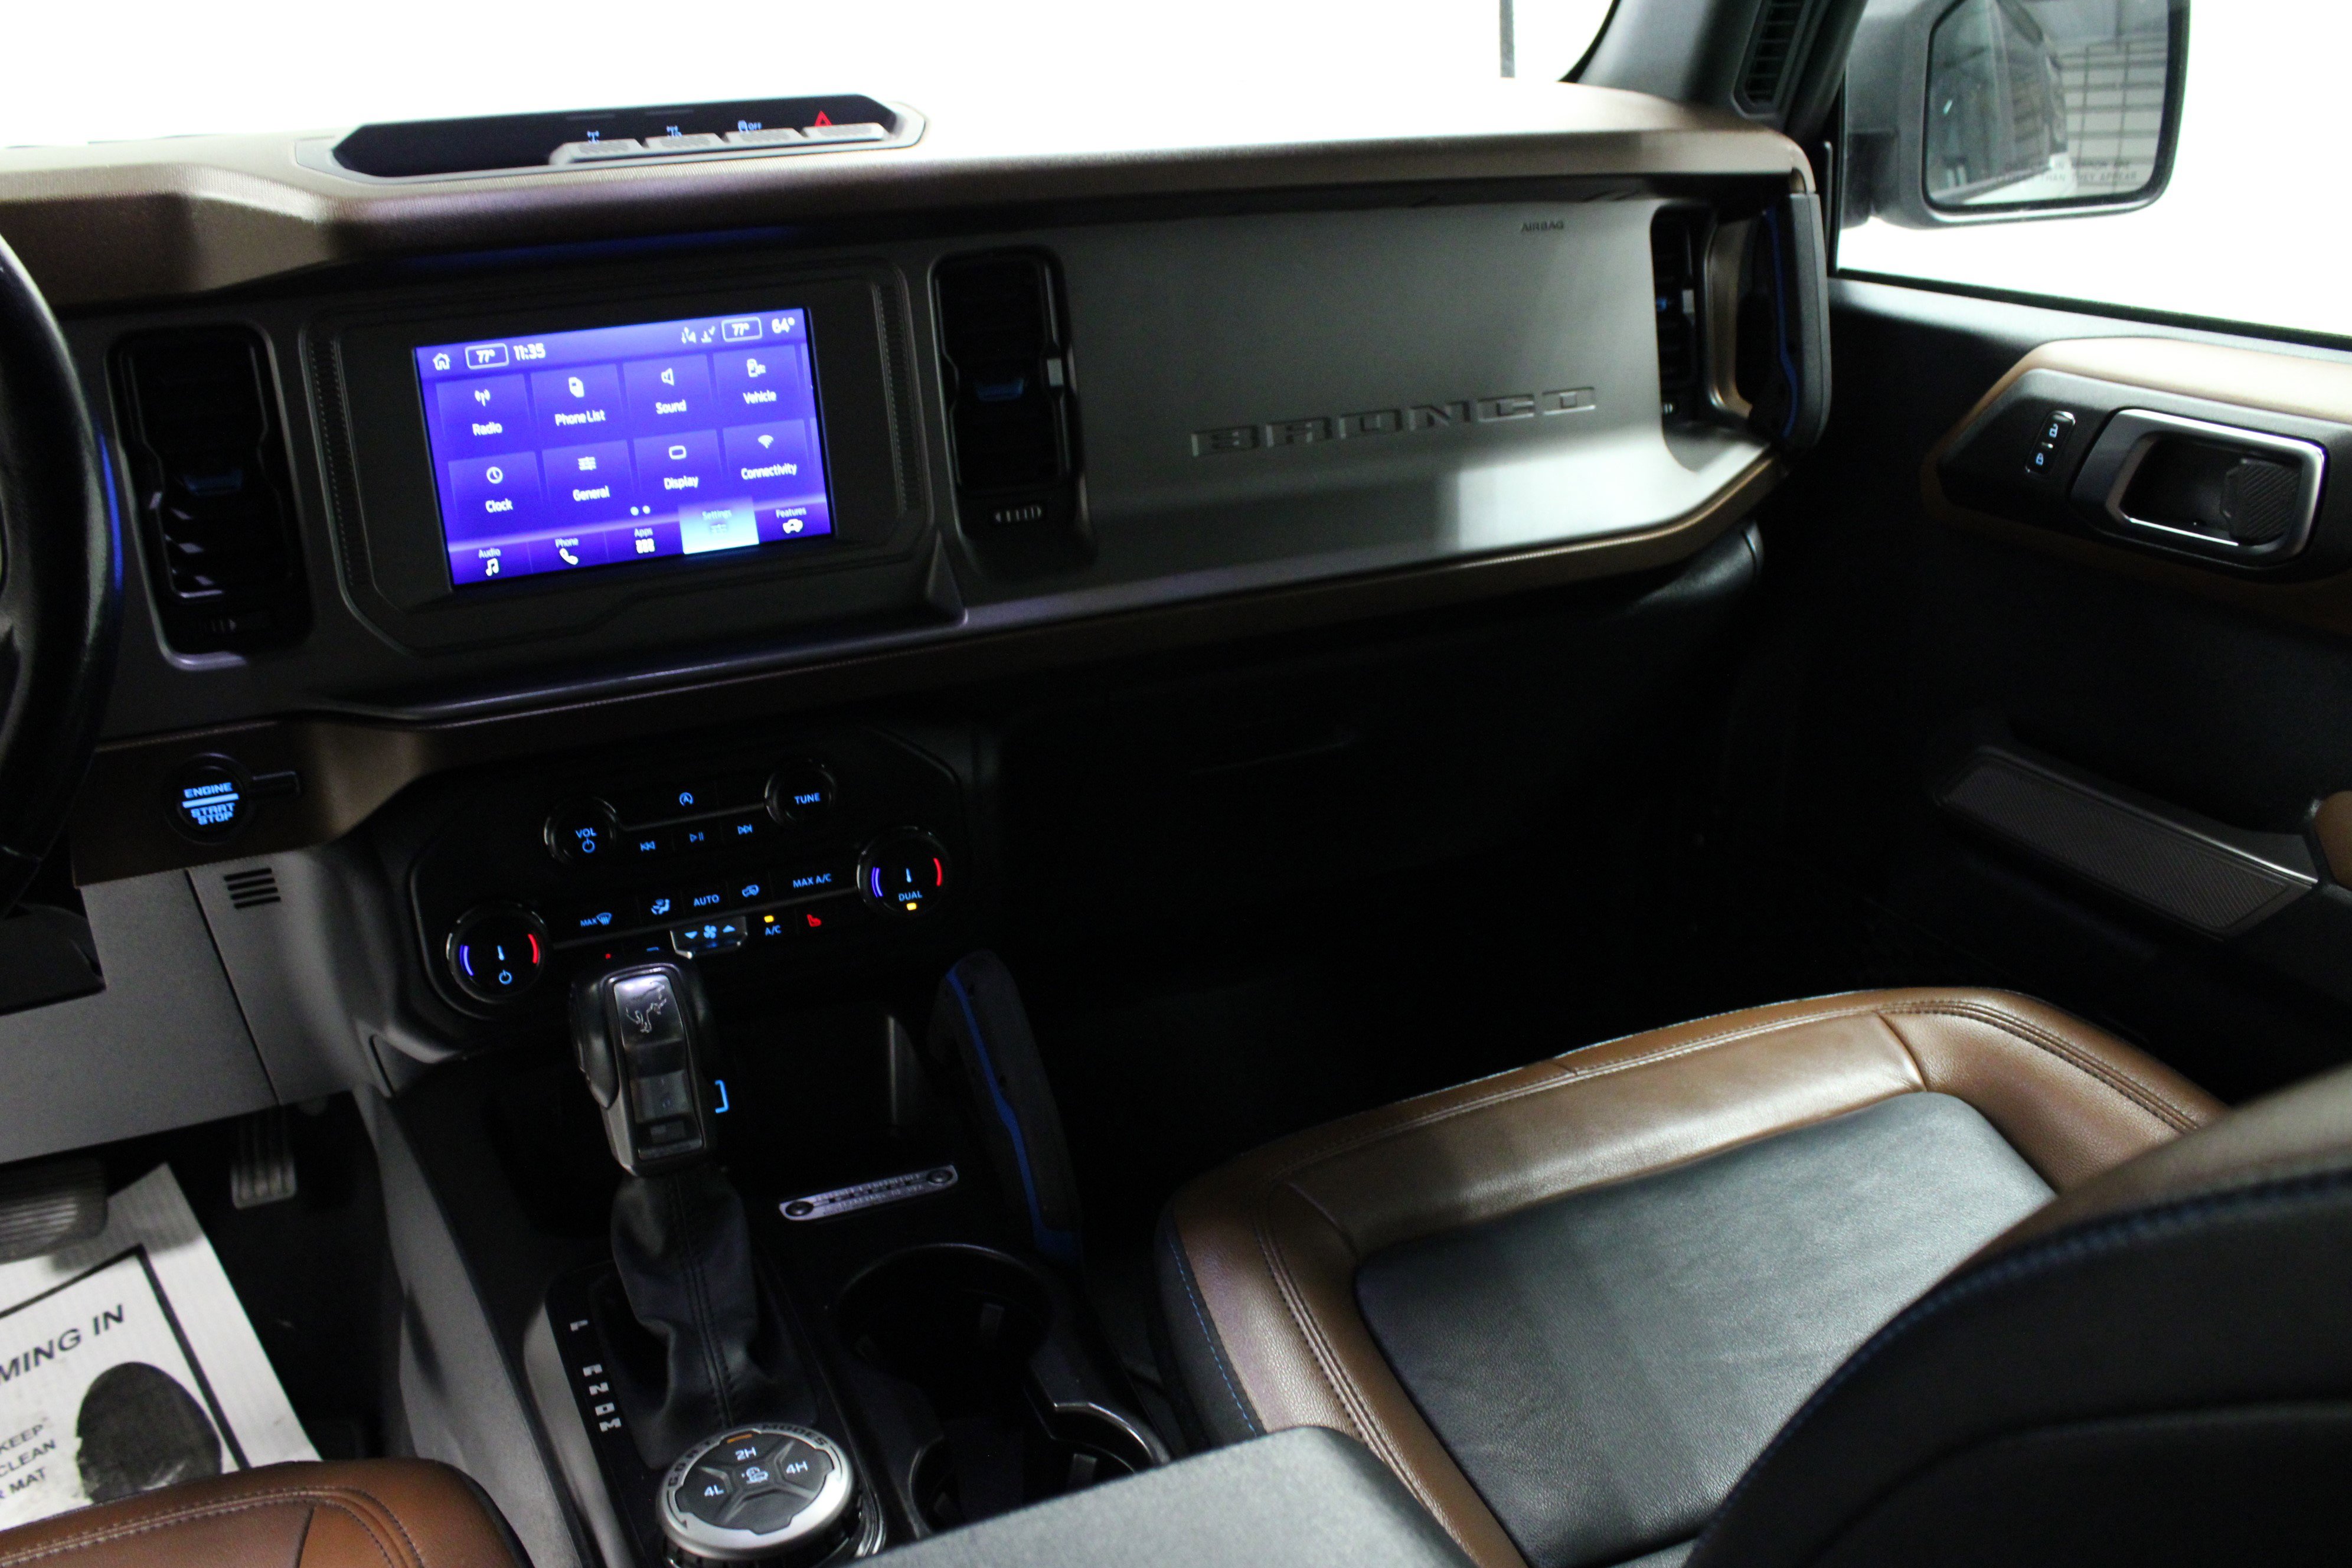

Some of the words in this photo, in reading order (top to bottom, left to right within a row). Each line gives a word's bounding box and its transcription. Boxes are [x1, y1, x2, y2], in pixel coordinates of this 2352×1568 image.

[513, 342, 546, 361] 11:35
[743, 390, 777, 404] Vehicle
[655, 399, 687, 414] Sound
[554, 411, 586, 426] Phone
[586, 409, 606, 423] List
[1191, 387, 1596, 457] BRONCO
[472, 422, 502, 436] Radio
[741, 463, 797, 480] Connectivity
[664, 475, 698, 490] Display
[572, 485, 610, 501] General
[485, 498, 513, 513] Clock
[775, 507, 807, 518] Features
[702, 509, 732, 520] Settings
[634, 528, 654, 538] Apps
[555, 538, 579, 548] Phone
[478, 547, 501, 559] Audio
[184, 782, 234, 799] ENGINE
[793, 792, 821, 805] TUNE
[190, 802, 236, 819] START
[197, 810, 234, 825] STOP
[575, 827, 597, 839] VOL
[792, 878, 814, 889] MAX
[815, 873, 832, 885] A/C
[693, 894, 720, 907] AUTO
[898, 890, 923, 903] DUAL
[580, 917, 598, 927] MAX
[765, 925, 782, 936] A/C
[93, 1304, 125, 1337] IN
[589, 1381, 609, 1396] N
[594, 1402, 616, 1416] D
[599, 1417, 622, 1433] M
[0, 1424, 44, 1455] KEEP
[0, 1438, 56, 1476] CLEAN
[736, 1446, 757, 1462] 2H
[786, 1461, 808, 1475] 4H
[9, 1466, 46, 1494] MAT
[704, 1484, 724, 1497] 4L
